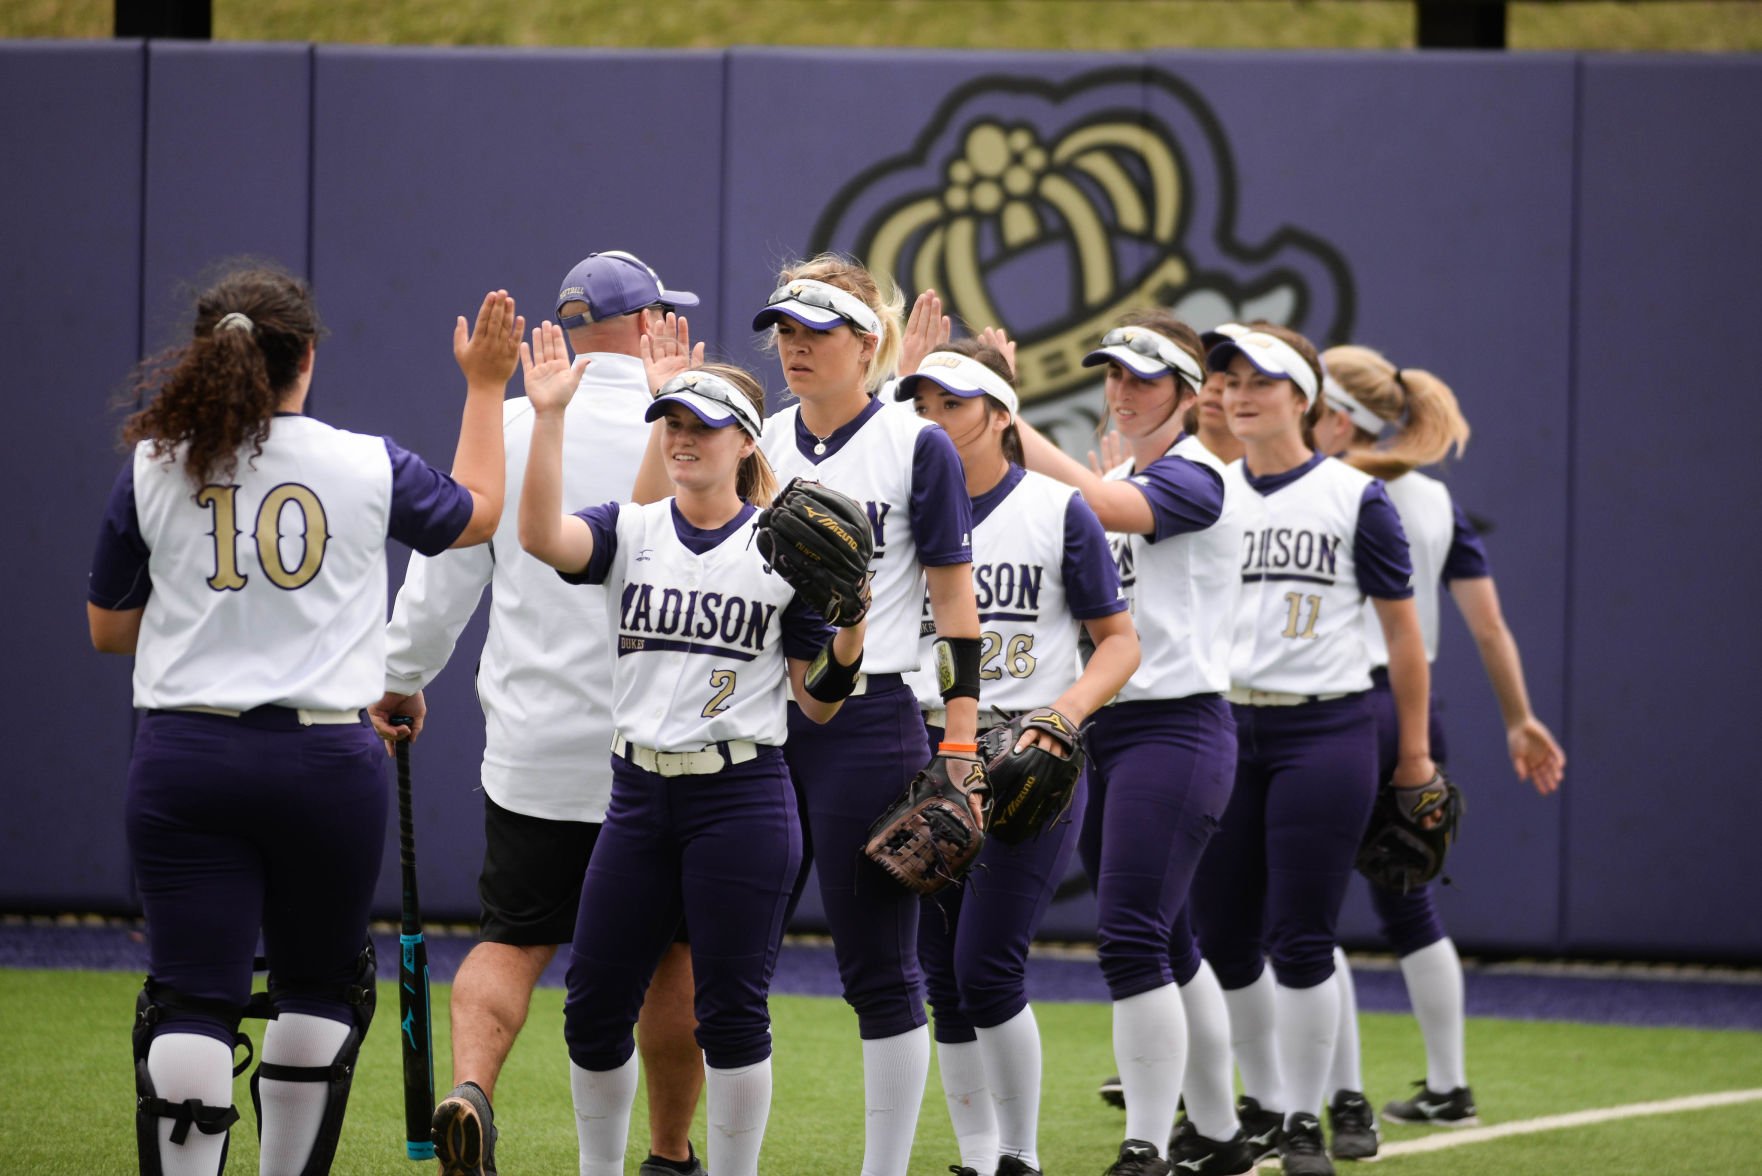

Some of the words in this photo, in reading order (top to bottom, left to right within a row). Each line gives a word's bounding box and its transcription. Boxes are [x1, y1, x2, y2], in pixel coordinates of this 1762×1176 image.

[197, 482, 332, 591] 10
[1281, 591, 1322, 639] 11
[621, 637, 645, 650] DUKES
[979, 630, 1038, 680] 26
[700, 668, 737, 718] 2
